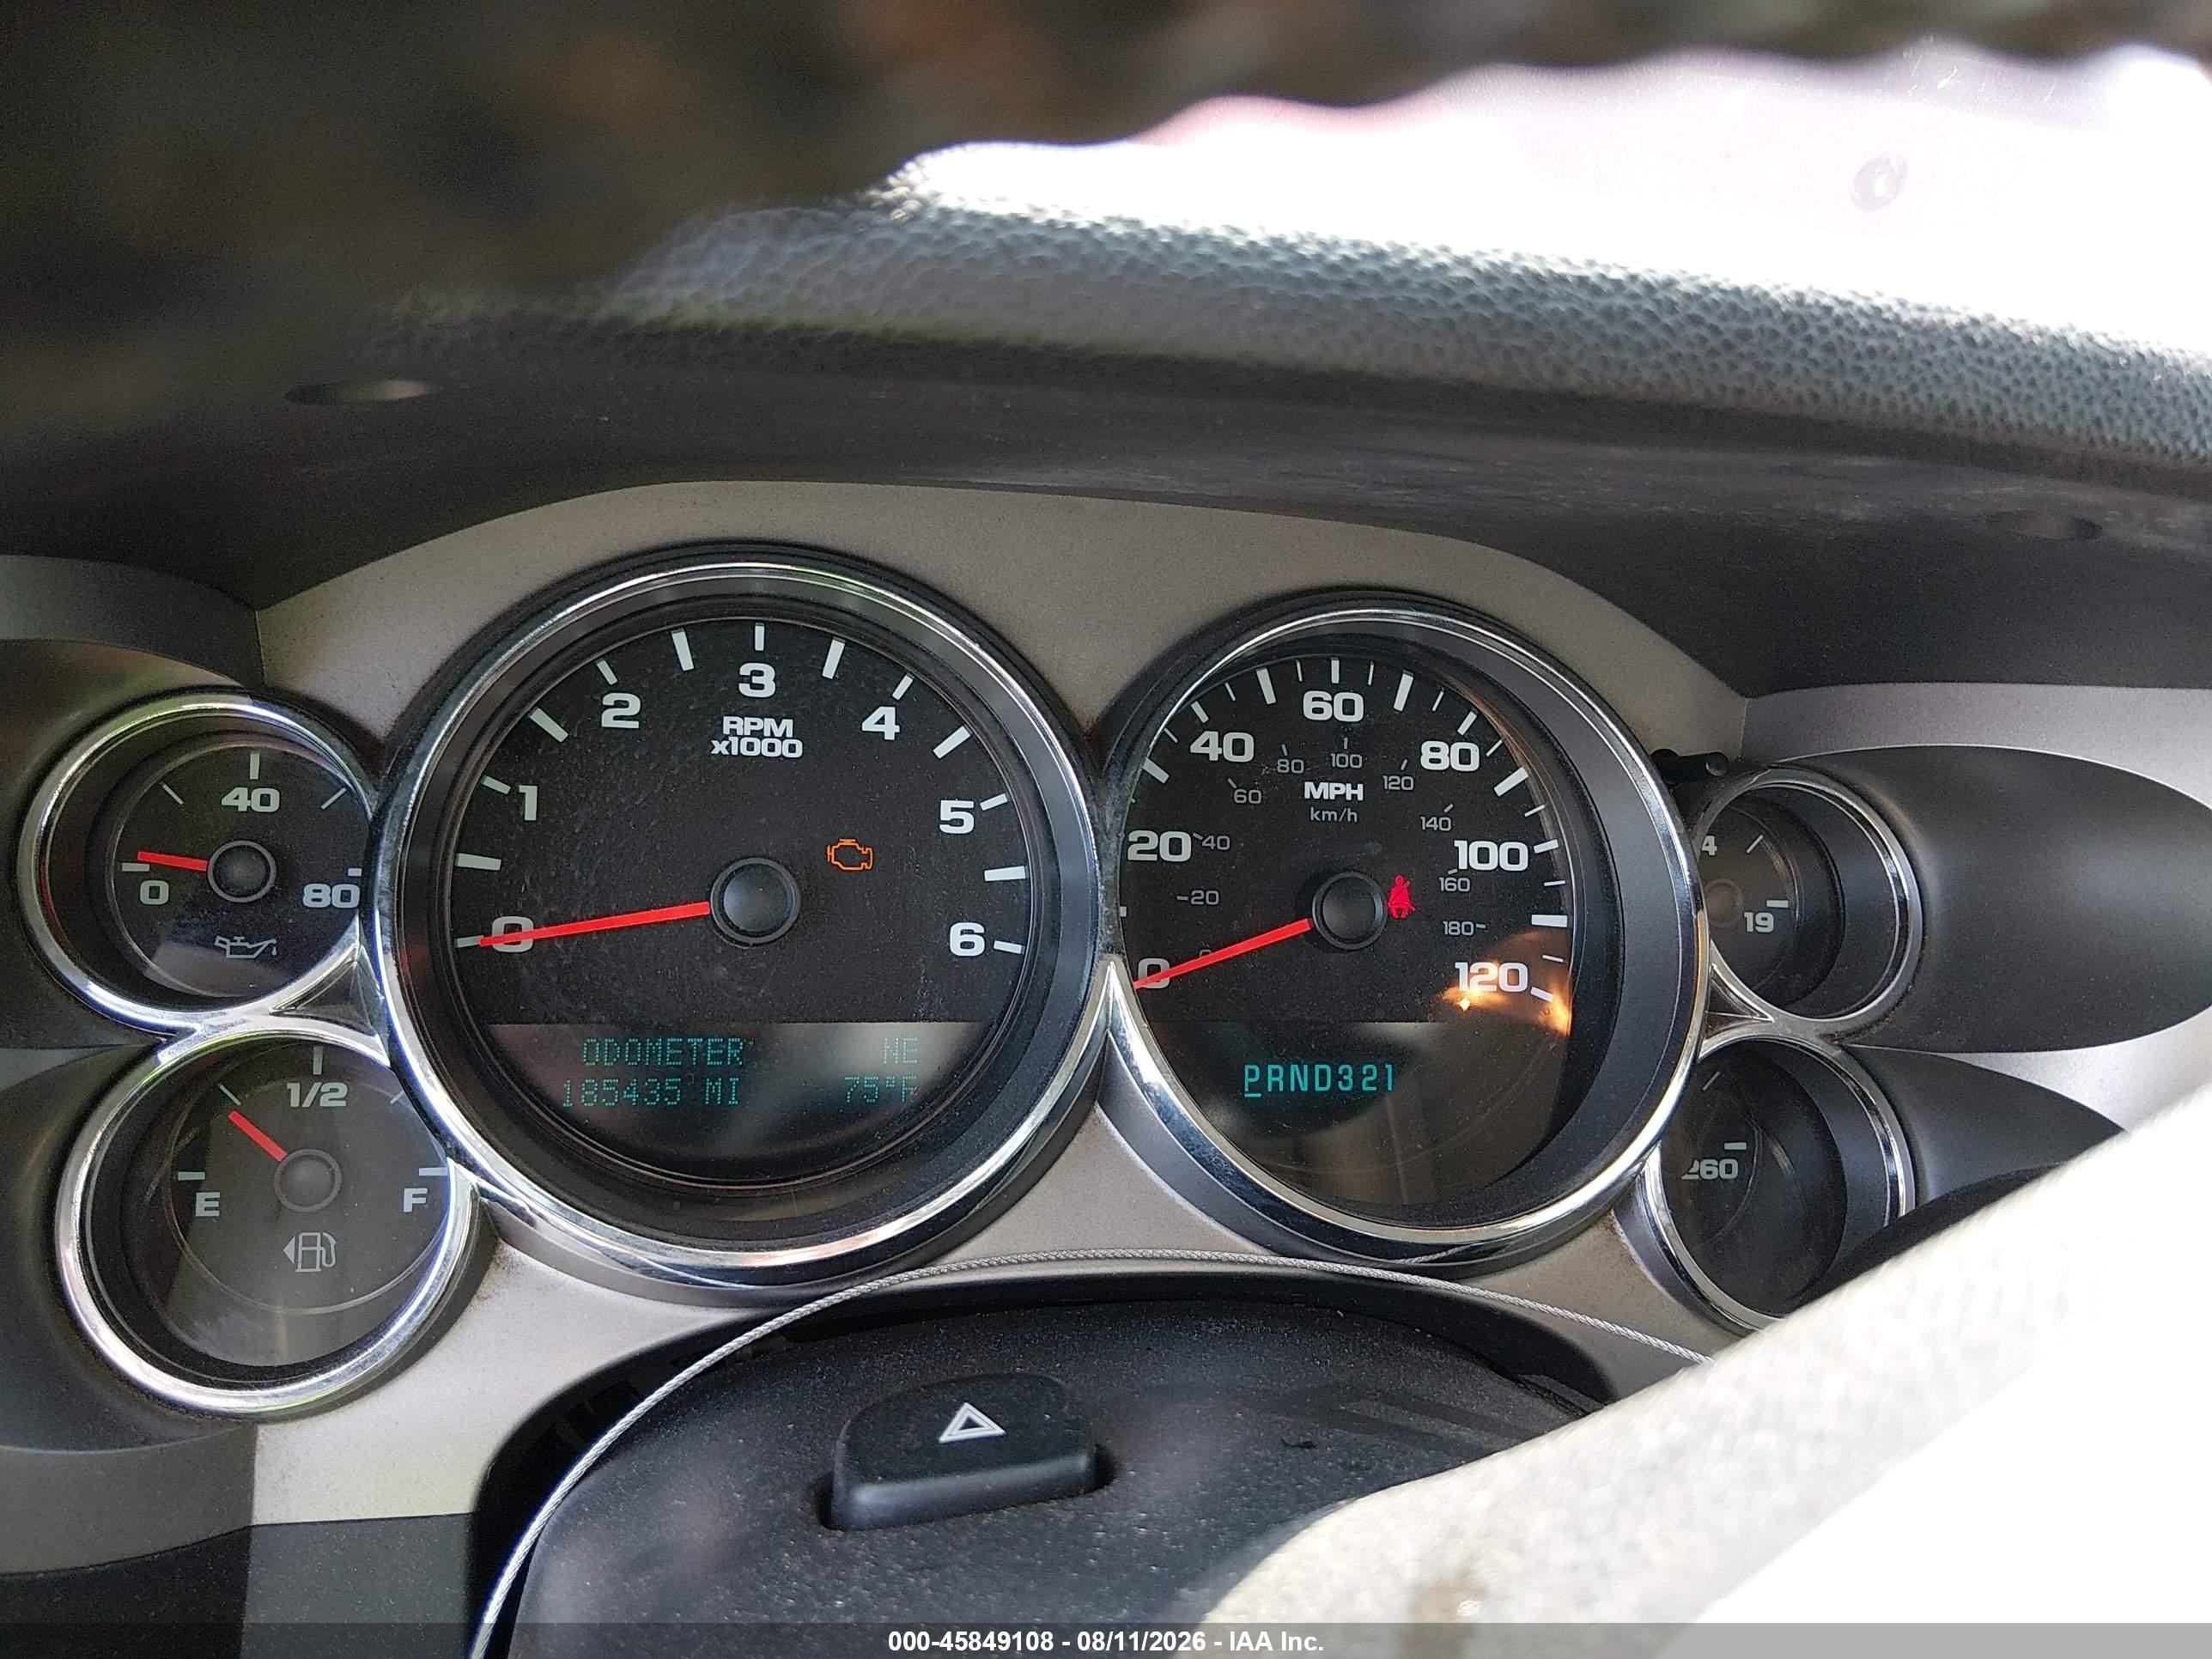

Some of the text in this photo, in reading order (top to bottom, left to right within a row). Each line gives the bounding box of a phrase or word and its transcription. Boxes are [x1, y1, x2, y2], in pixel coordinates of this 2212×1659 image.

[738, 662, 776, 698] 3
[601, 692, 641, 729] 2
[1303, 690, 1365, 722] 60
[722, 716, 793, 738] RPM
[861, 706, 901, 740] 4
[711, 738, 803, 758] x1000
[1190, 731, 1255, 763] 40
[1330, 752, 1364, 769] 100
[1420, 741, 1480, 772] 80
[1276, 758, 1304, 774] 80
[1304, 781, 1364, 801] MPH
[1382, 775, 1414, 791] 120
[221, 787, 281, 812] 40
[519, 784, 538, 821] 1
[1233, 789, 1262, 805] 60
[939, 799, 975, 834] 5
[1310, 806, 1358, 823] km/h
[1420, 816, 1452, 832] 140
[1127, 830, 1192, 861] 20
[1202, 835, 1231, 851] 40
[1455, 840, 1529, 872] 100
[139, 880, 169, 905] 0
[302, 883, 361, 909] 80
[1190, 890, 1220, 905] 20
[1439, 877, 1471, 892] 160
[491, 915, 534, 953] 0
[1443, 921, 1474, 937] 180
[1743, 911, 1774, 933] 19
[949, 922, 985, 957] 6
[1455, 962, 1528, 993] 120
[582, 1037, 744, 1067] ODOMETER
[883, 1036, 919, 1065] NE
[561, 1077, 740, 1109] 185435 MI
[1243, 1064, 1395, 1097] PRND321
[287, 1082, 349, 1109] 1/2
[195, 1191, 221, 1218] E
[403, 1188, 428, 1213] F
